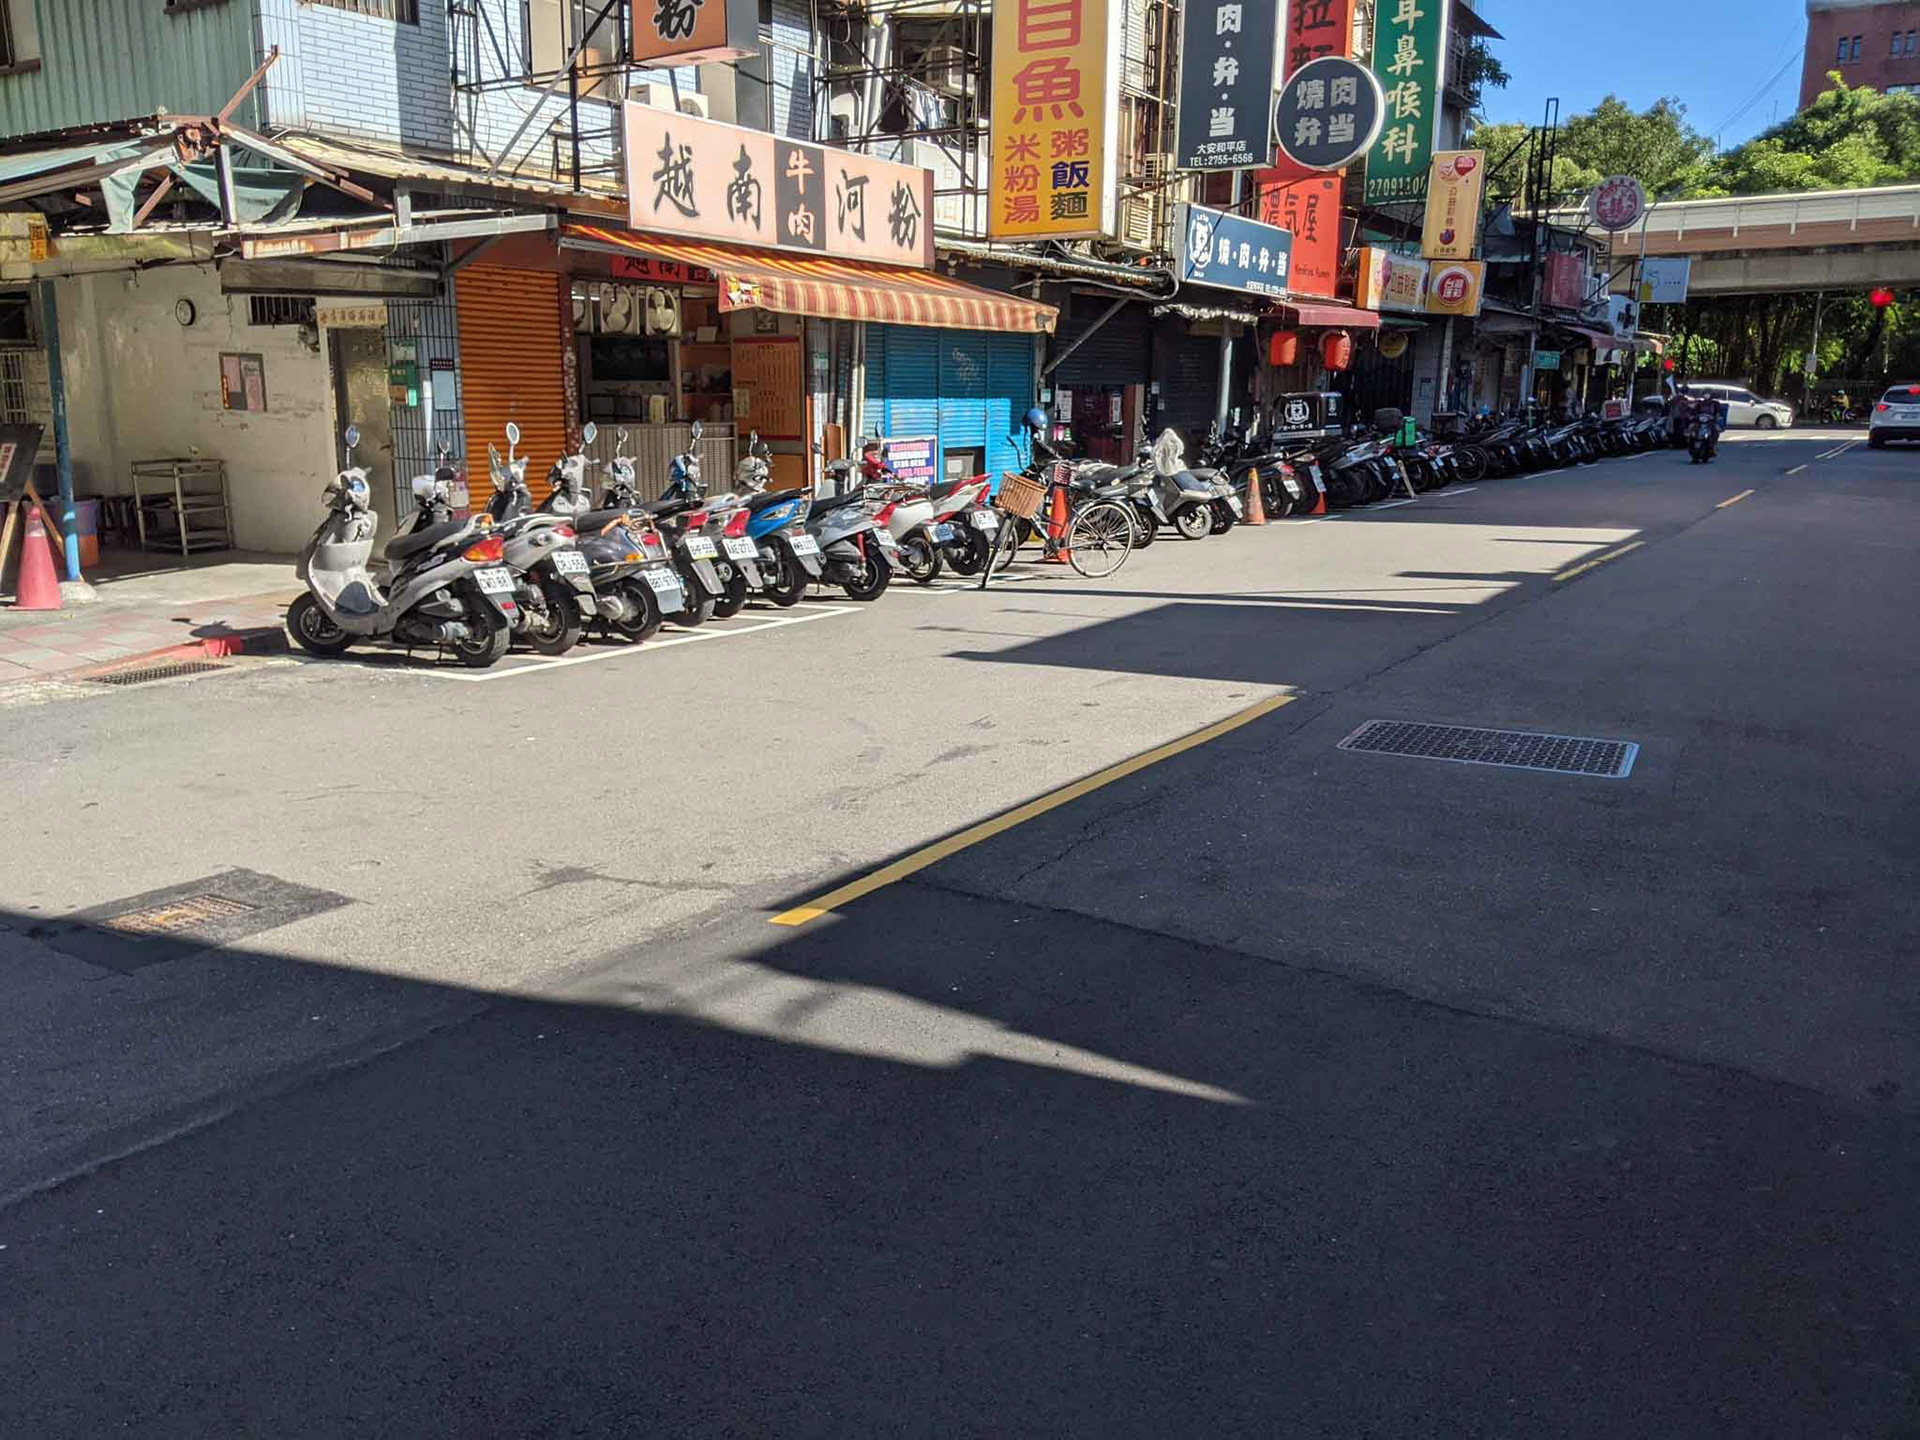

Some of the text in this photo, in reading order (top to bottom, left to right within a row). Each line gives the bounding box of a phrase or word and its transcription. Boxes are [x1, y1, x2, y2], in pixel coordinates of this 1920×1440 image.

[652, 130, 922, 252] 越南 牛肉 河粉
[1004, 132, 1041, 225] 米粉湯
[1050, 128, 1090, 220] 粥飯麵
[1196, 141, 1247, 155] 大安和平店
